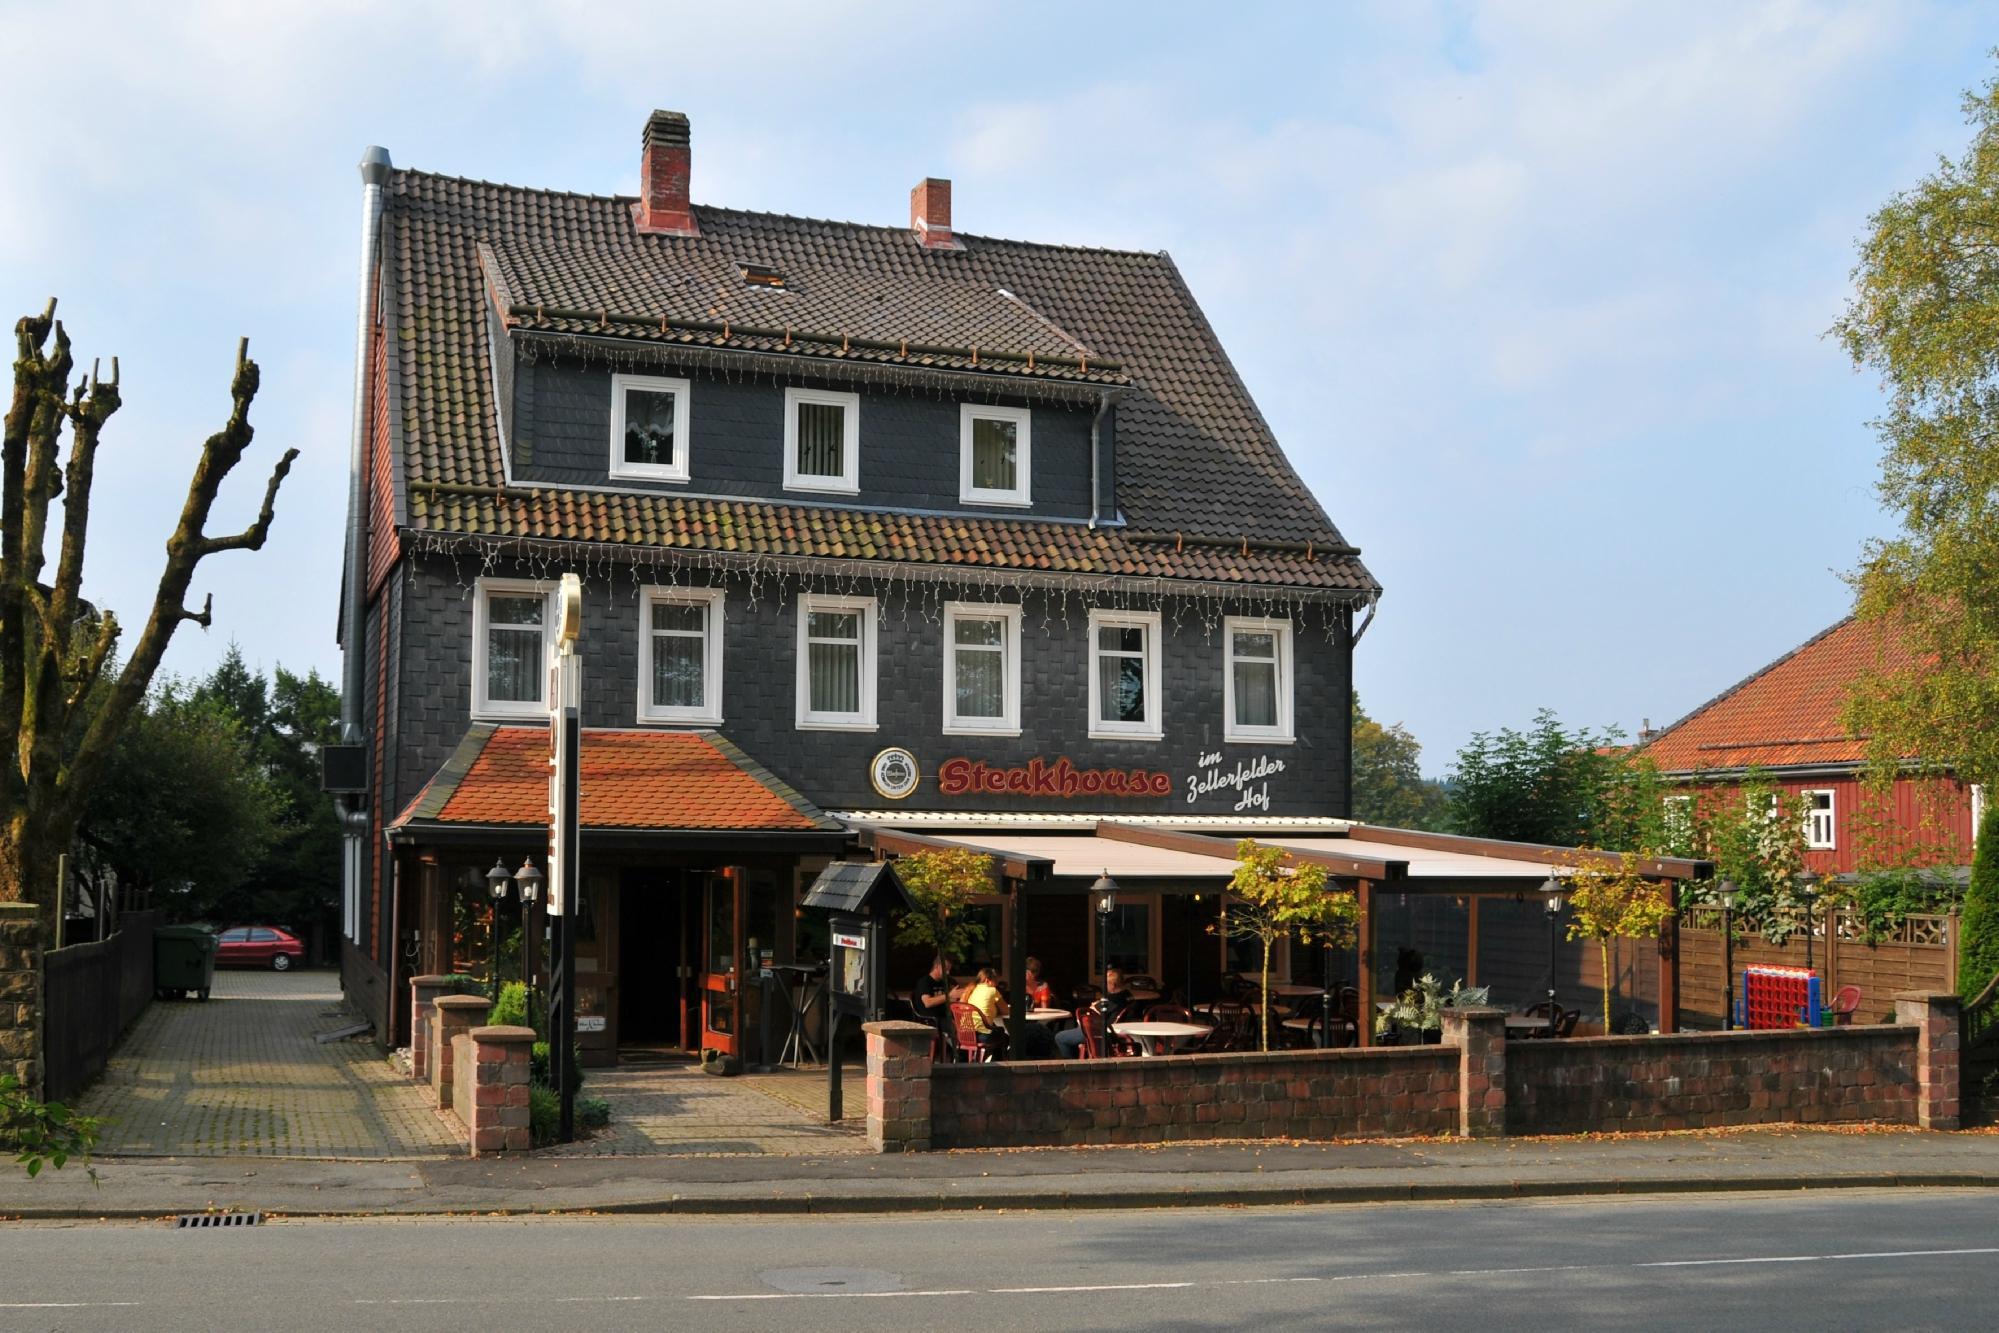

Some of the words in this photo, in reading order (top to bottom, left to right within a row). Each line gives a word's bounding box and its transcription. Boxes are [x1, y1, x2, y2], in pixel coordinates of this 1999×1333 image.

[939, 756, 1171, 797] Steakhouse
[1198, 751, 1222, 768] im
[1186, 755, 1286, 803] Zellerfelder
[1234, 782, 1270, 811] Hof
